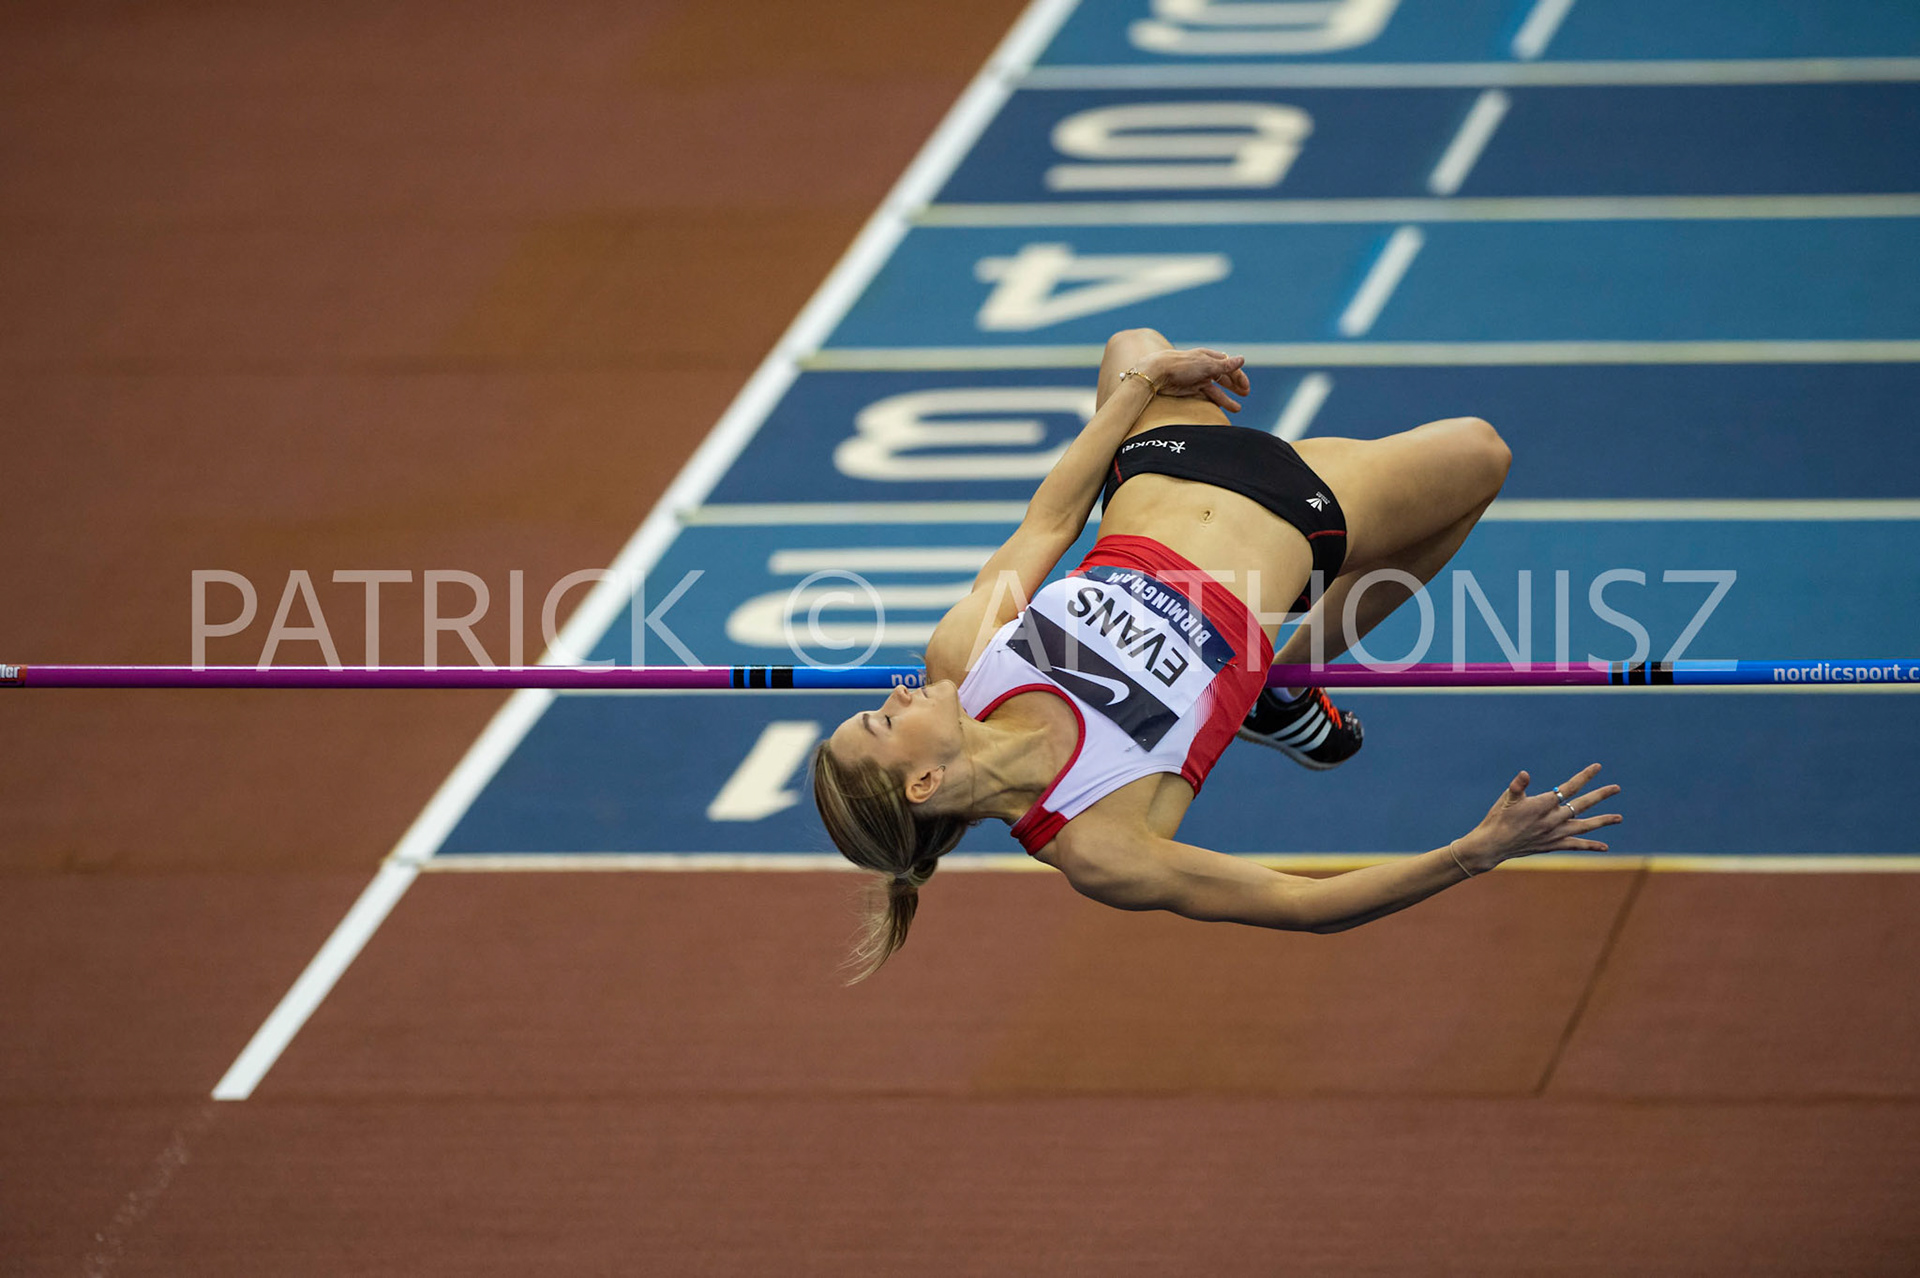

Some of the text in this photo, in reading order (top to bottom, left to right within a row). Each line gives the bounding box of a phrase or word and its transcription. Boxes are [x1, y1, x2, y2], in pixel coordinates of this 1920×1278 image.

[1045, 101, 1314, 192] 5
[973, 242, 1232, 332] 4
[833, 385, 1098, 482] 3
[1122, 439, 1168, 454] KUKRI
[1066, 586, 1189, 688] EVANS
[1106, 571, 1212, 648] BIRMINGHAM
[0, 664, 20, 679] ler
[705, 719, 822, 822] 1
